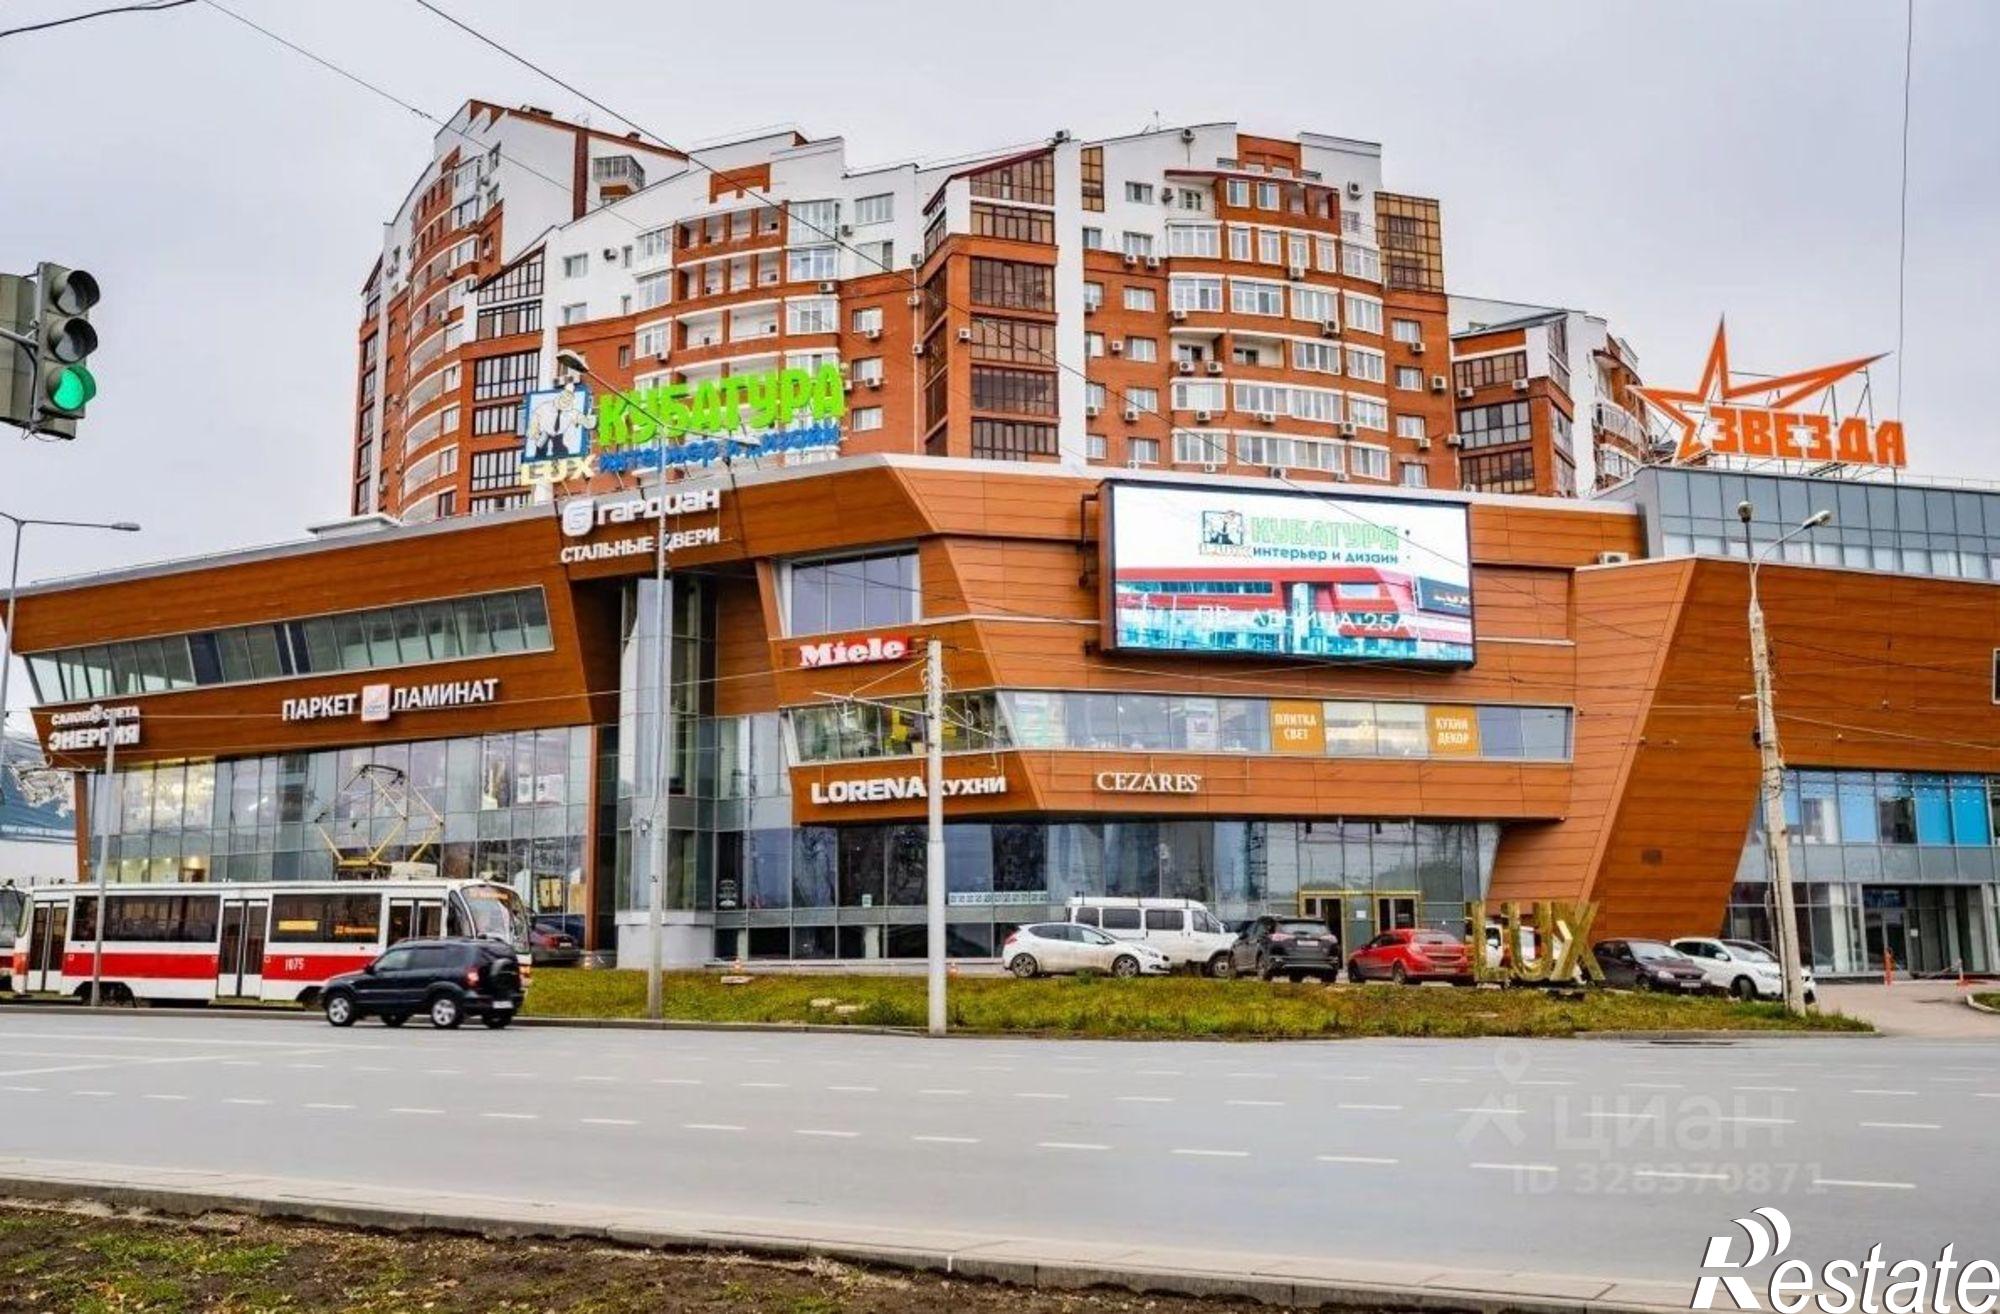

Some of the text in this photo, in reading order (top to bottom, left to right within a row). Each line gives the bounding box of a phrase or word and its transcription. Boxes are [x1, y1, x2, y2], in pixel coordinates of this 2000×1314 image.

[598, 362, 845, 447] КУБАТУРА
[1708, 405, 1908, 469] ЗВЕЗДА
[520, 454, 597, 486] LUX
[1251, 517, 1400, 550] КУБАТУРА
[561, 535, 656, 564] СТАЛЬНЫЕ
[1253, 547, 1327, 562] интерьер
[1332, 552, 1341, 560] и
[799, 638, 905, 667] Miele
[282, 678, 498, 721] ПАРКЕТ ЛАМИНАТ
[1275, 713, 1317, 726] ПЛИТКА
[1435, 718, 1468, 730] КУХНИ
[48, 724, 139, 751] ЭНЕРГИЯ
[1284, 729, 1308, 740] СВЕТ
[1438, 732, 1469, 745] ДЕКОР
[811, 776, 927, 804] LORENA
[1097, 771, 1199, 793] CEZARES
[1465, 901, 1605, 981] LUX
